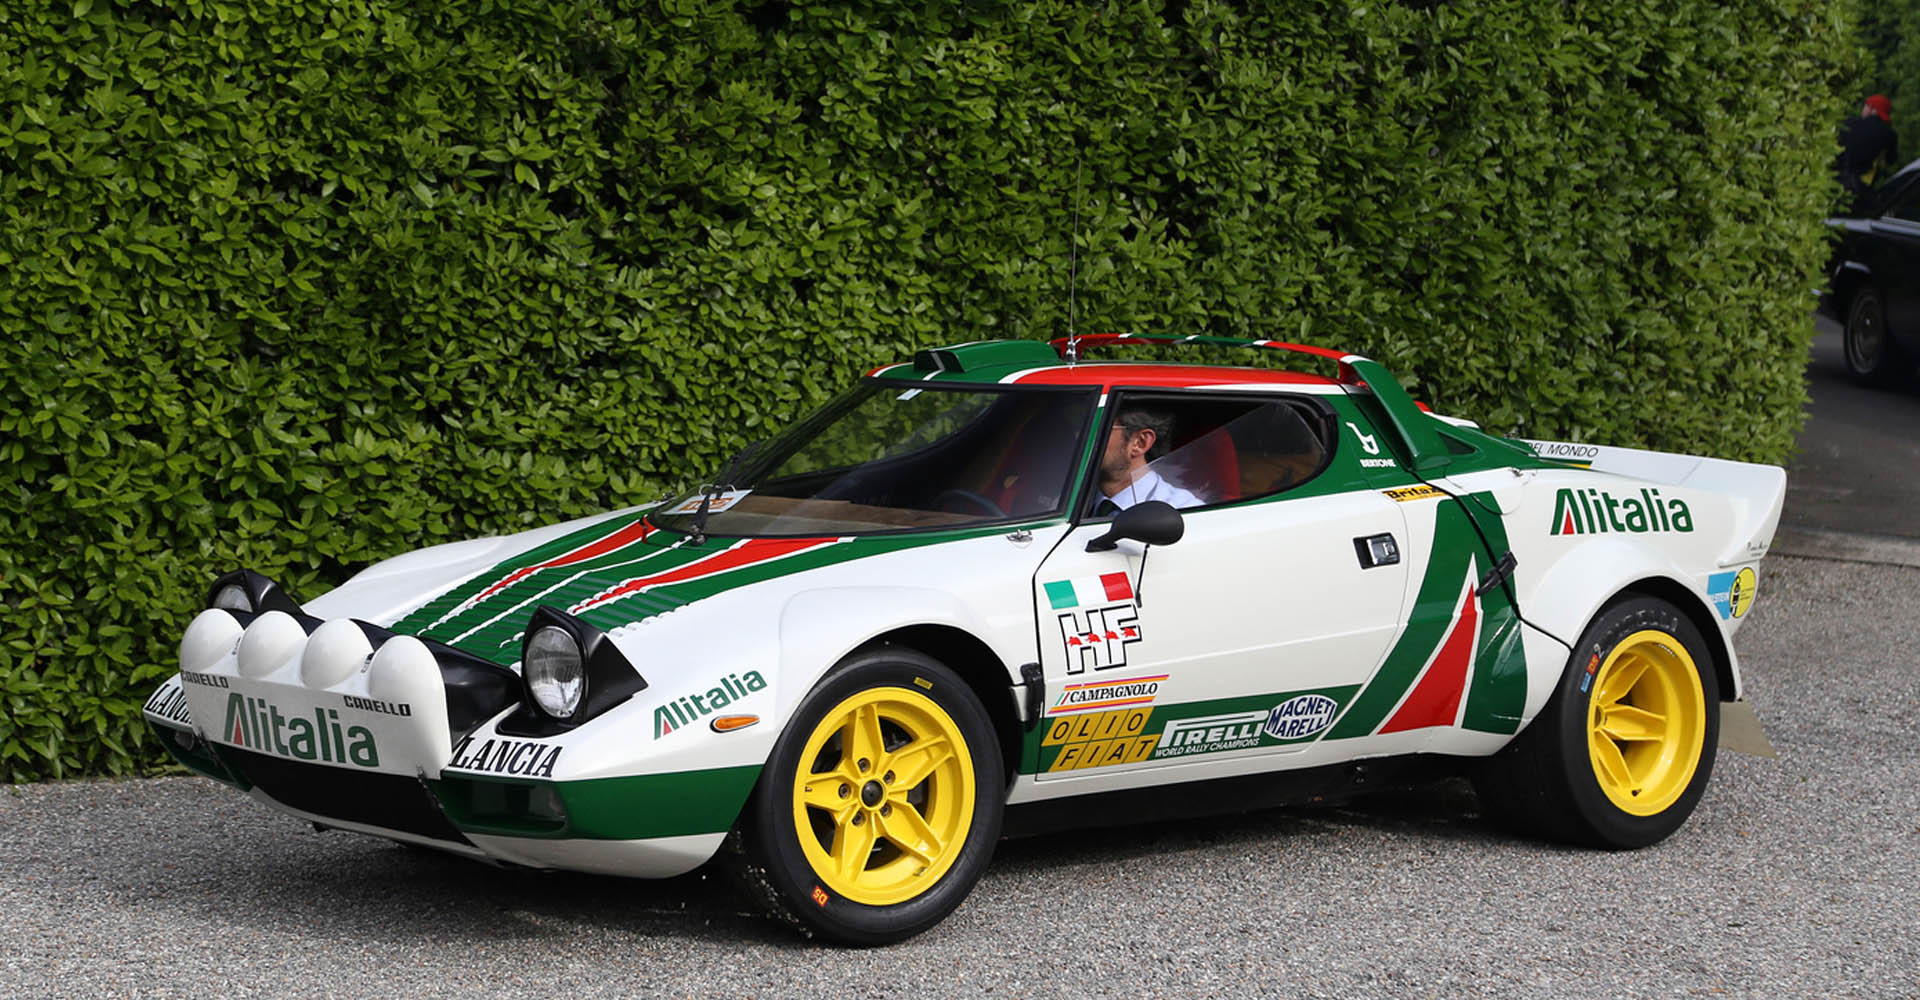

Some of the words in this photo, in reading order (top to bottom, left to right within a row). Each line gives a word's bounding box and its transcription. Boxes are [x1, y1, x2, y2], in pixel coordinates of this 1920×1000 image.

[1547, 444, 1599, 457] MONDO
[1550, 488, 1694, 536] Alitalia
[1057, 603, 1142, 675] HF
[344, 695, 412, 717] CARELLO
[654, 670, 767, 739] Alitalia
[1070, 682, 1158, 703] CAMPAGNOLO
[1267, 697, 1336, 726] MAGNETI
[1267, 709, 1335, 738] MARELLI
[223, 692, 379, 767] Alitalia
[1052, 713, 1143, 740] OLIO
[1158, 710, 1269, 748] PIRELLI
[448, 737, 563, 778] LANCIA
[1059, 740, 1154, 767] FIAT
[1155, 746, 1184, 757] WORLD
[1185, 744, 1209, 754] RALLY
[1209, 738, 1260, 752] CHAMPIONS
